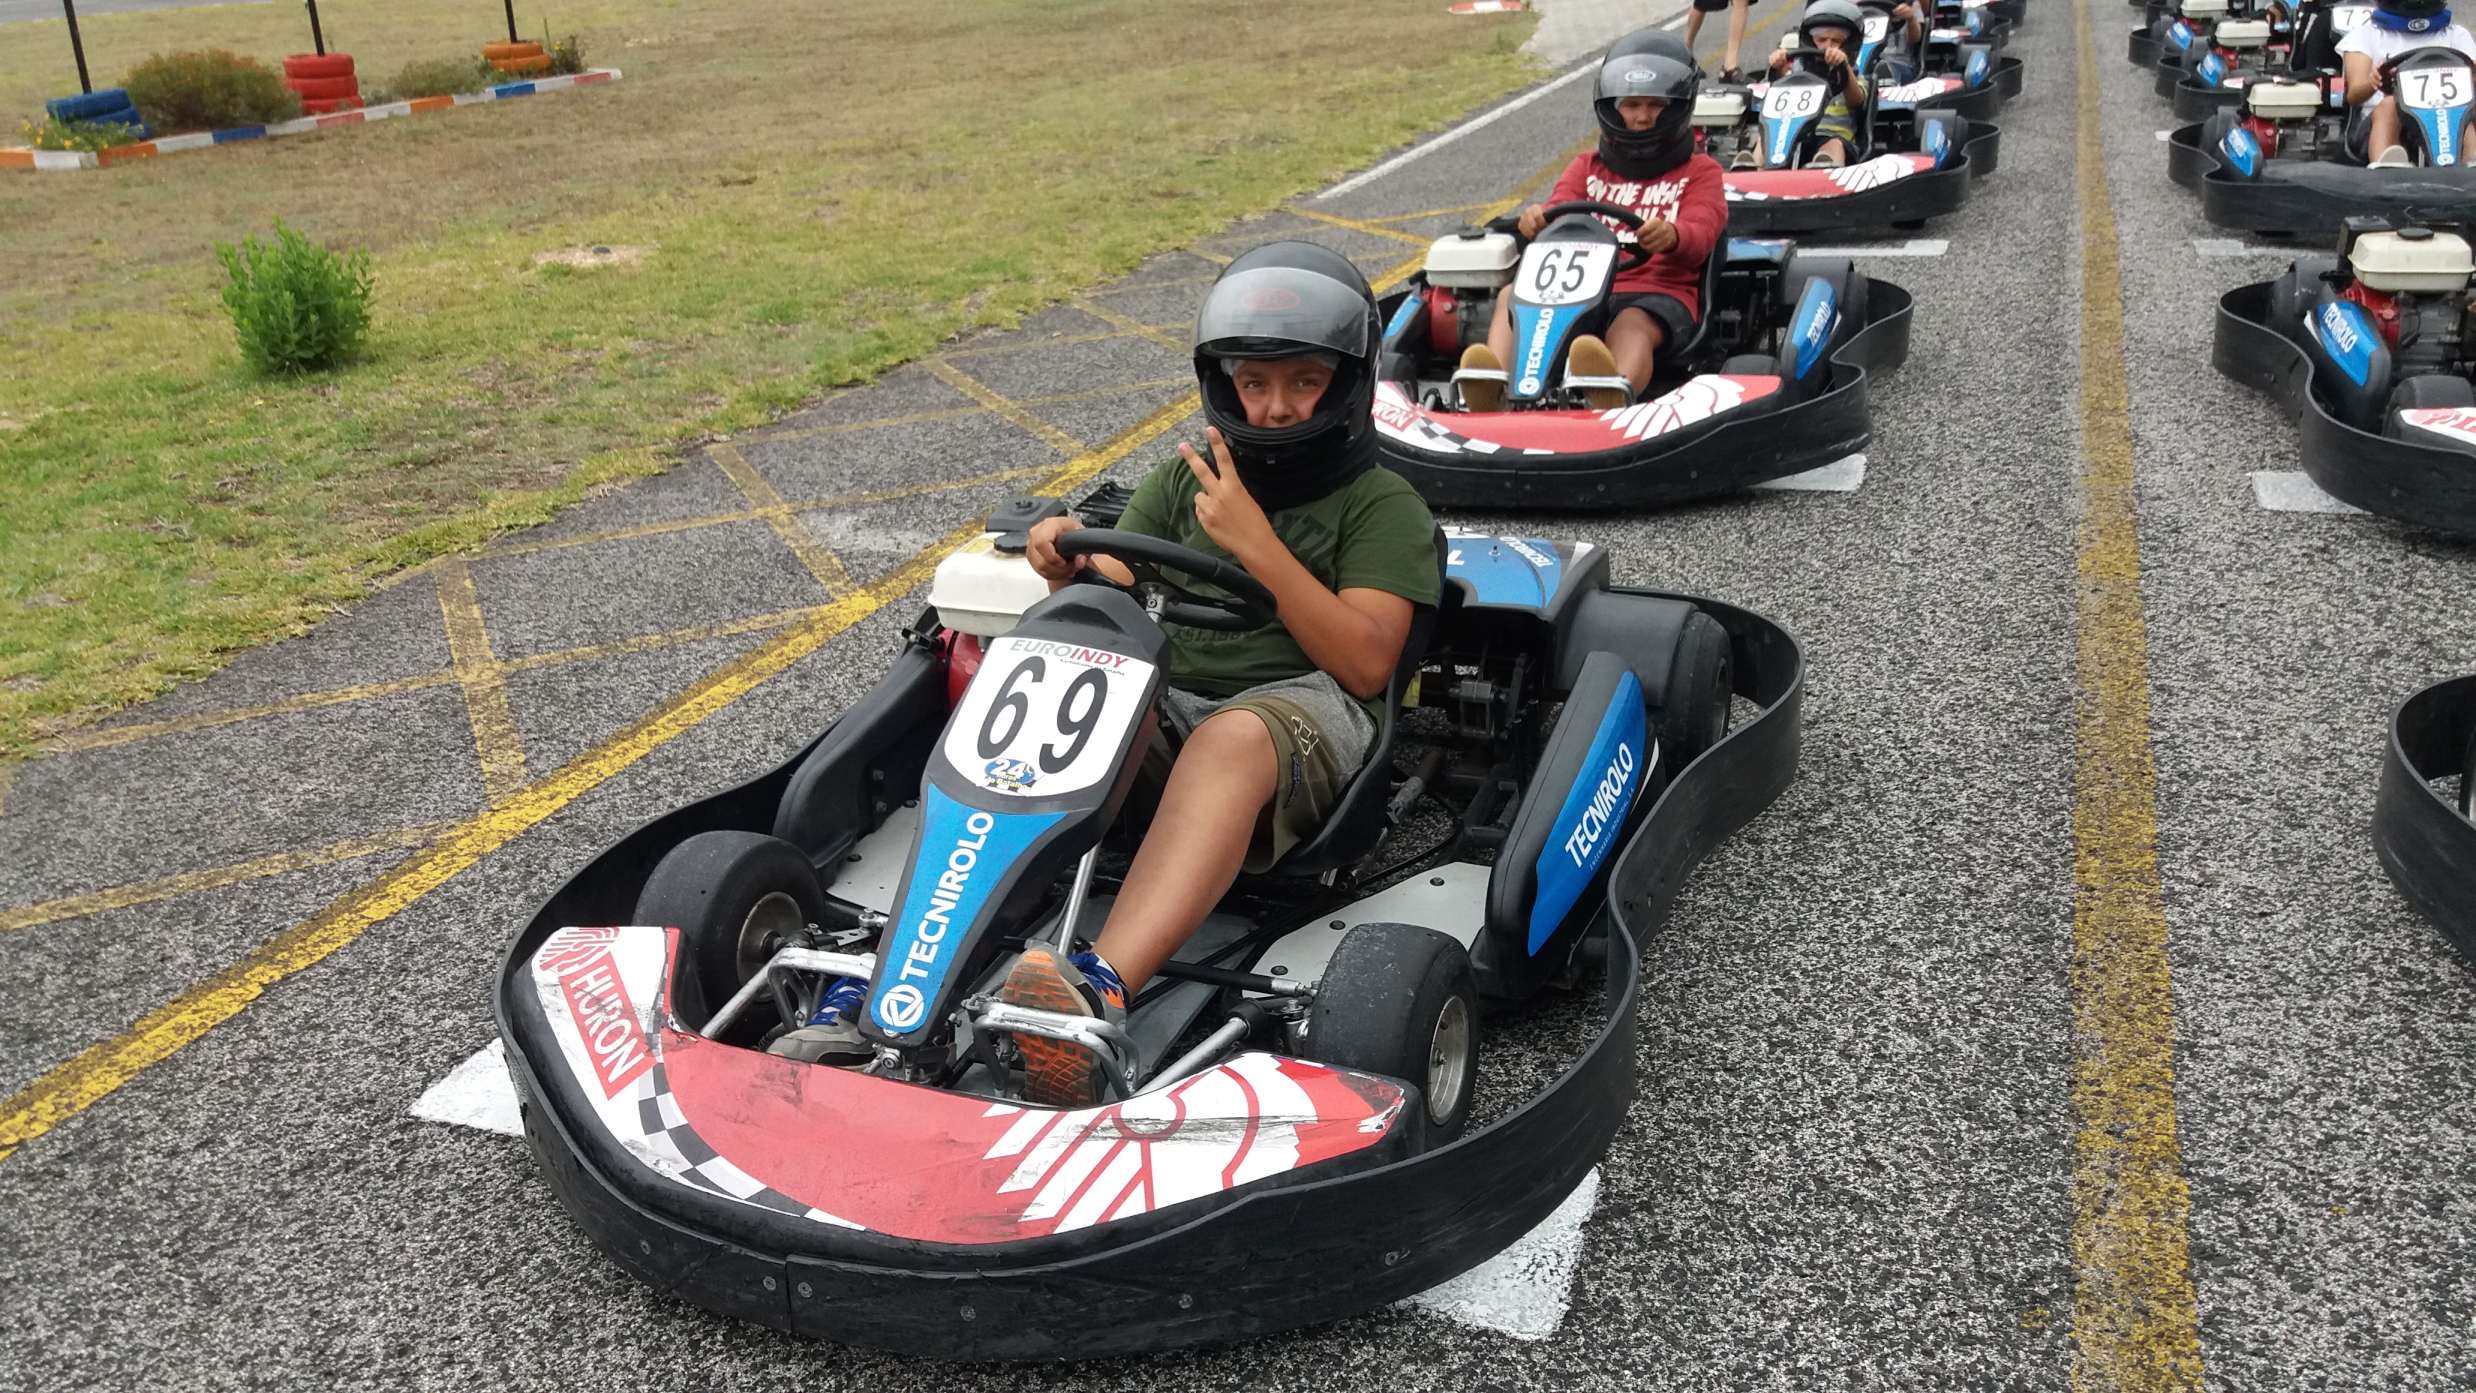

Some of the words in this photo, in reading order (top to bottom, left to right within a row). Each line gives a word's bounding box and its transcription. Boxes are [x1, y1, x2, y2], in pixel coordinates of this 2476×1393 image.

[1775, 90, 1812, 112] 68
[2413, 72, 2458, 102] 75
[1535, 248, 1590, 293] 65
[1372, 402, 1414, 428] RON
[1010, 639, 1130, 668] EUROINDY
[977, 655, 1108, 775] 69
[1565, 742, 1634, 868] TECNIROLO
[900, 811, 994, 982] TECNIROLO
[569, 961, 646, 1085] HURON
